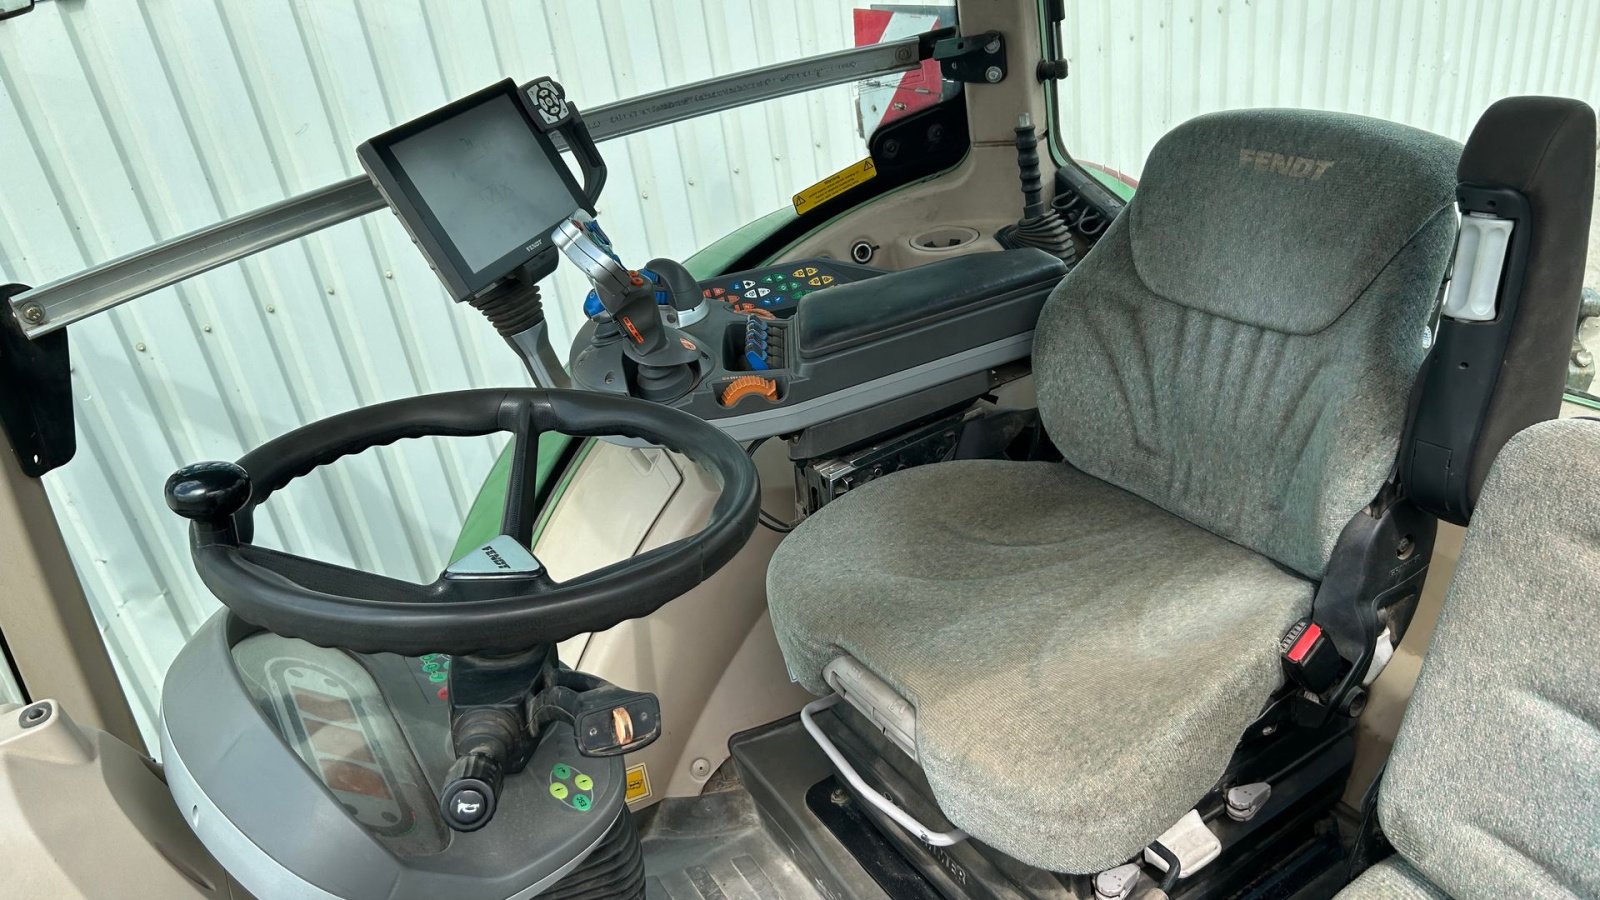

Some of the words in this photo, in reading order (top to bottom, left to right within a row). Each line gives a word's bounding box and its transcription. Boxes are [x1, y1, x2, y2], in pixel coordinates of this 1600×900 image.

[1239, 148, 1335, 180] FENDT
[526, 238, 543, 252] FENDT
[481, 545, 512, 569] FENDT
[576, 796, 587, 807] ESC
